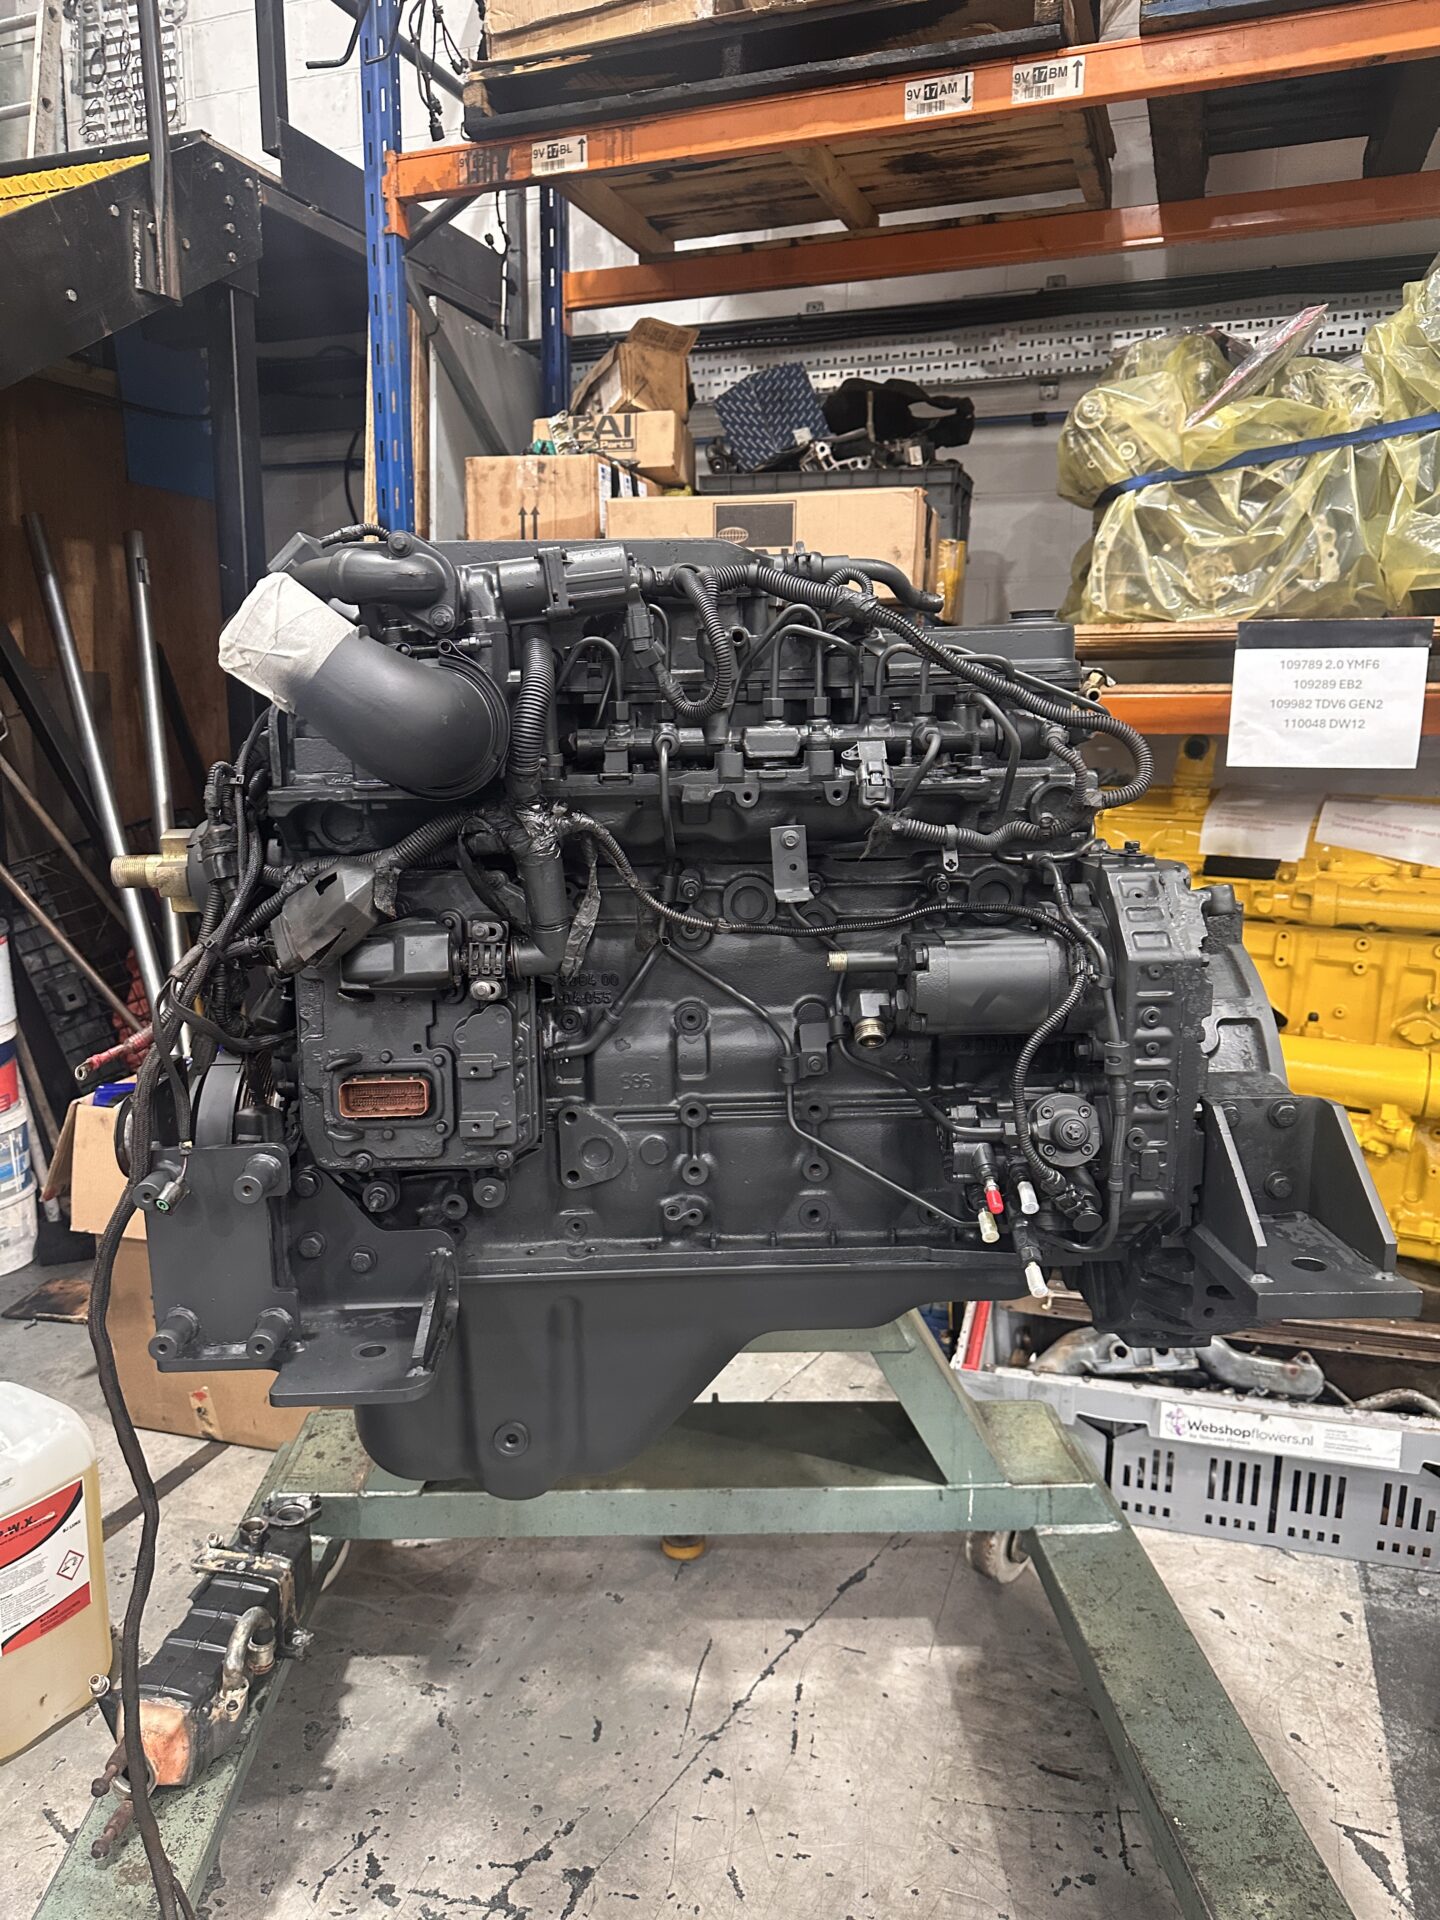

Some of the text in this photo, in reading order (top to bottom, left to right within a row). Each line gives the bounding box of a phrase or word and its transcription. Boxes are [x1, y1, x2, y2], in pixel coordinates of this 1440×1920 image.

[1014, 66, 1068, 85] 9V 17 BM
[906, 82, 958, 101] 9V 17 AM
[533, 147, 545, 159] 9V
[560, 144, 572, 155] BL
[600, 440, 632, 449] Parts
[1280, 659, 1380, 670] 109789 2.0 YMF6
[1294, 679, 1363, 690] 109289 EB2
[1270, 699, 1384, 710] 109982 TDV6 GEN2
[1284, 719, 1366, 729] 110048 DW12
[1187, 1418, 1314, 1446] Webshopflowers.nl
